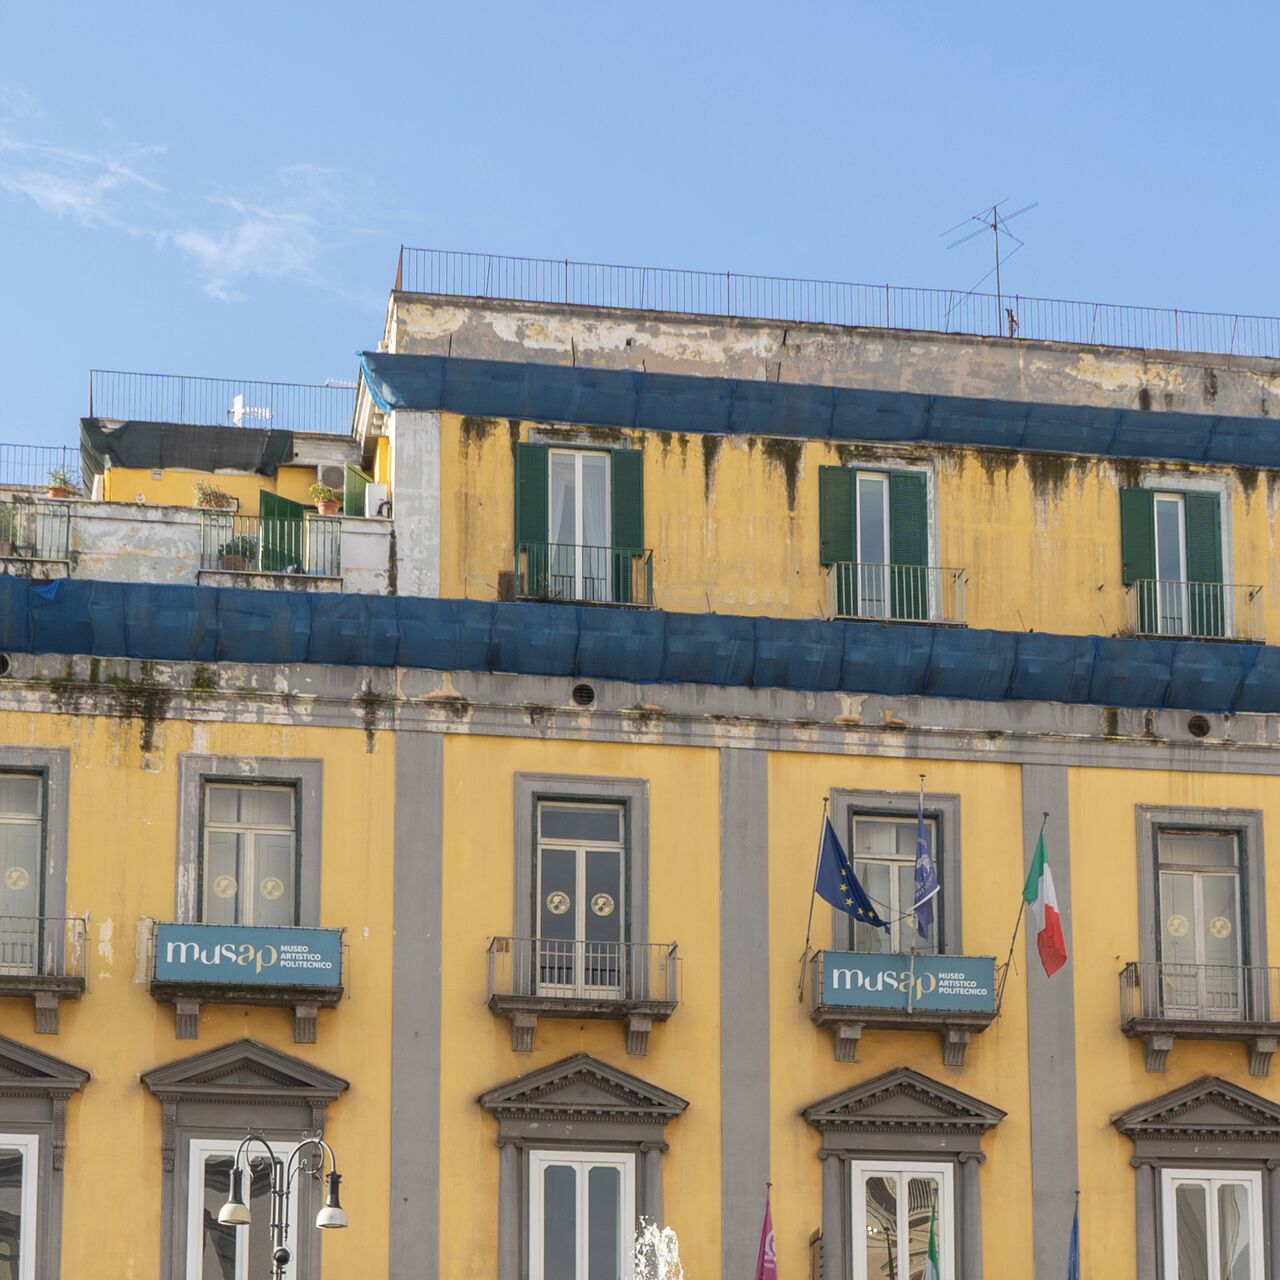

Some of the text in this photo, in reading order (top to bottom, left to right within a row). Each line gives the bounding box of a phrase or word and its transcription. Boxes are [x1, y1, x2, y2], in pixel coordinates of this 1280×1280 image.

[280, 945, 309, 953] MUSEO
[166, 941, 278, 975] musap
[280, 952, 321, 961] ARTISTICO
[280, 960, 332, 969] POLITECNICO
[938, 972, 965, 980] MUSEO
[832, 968, 937, 1001] musap
[938, 980, 977, 988] ARTISTICO
[938, 987, 988, 996] POLITECNICO
